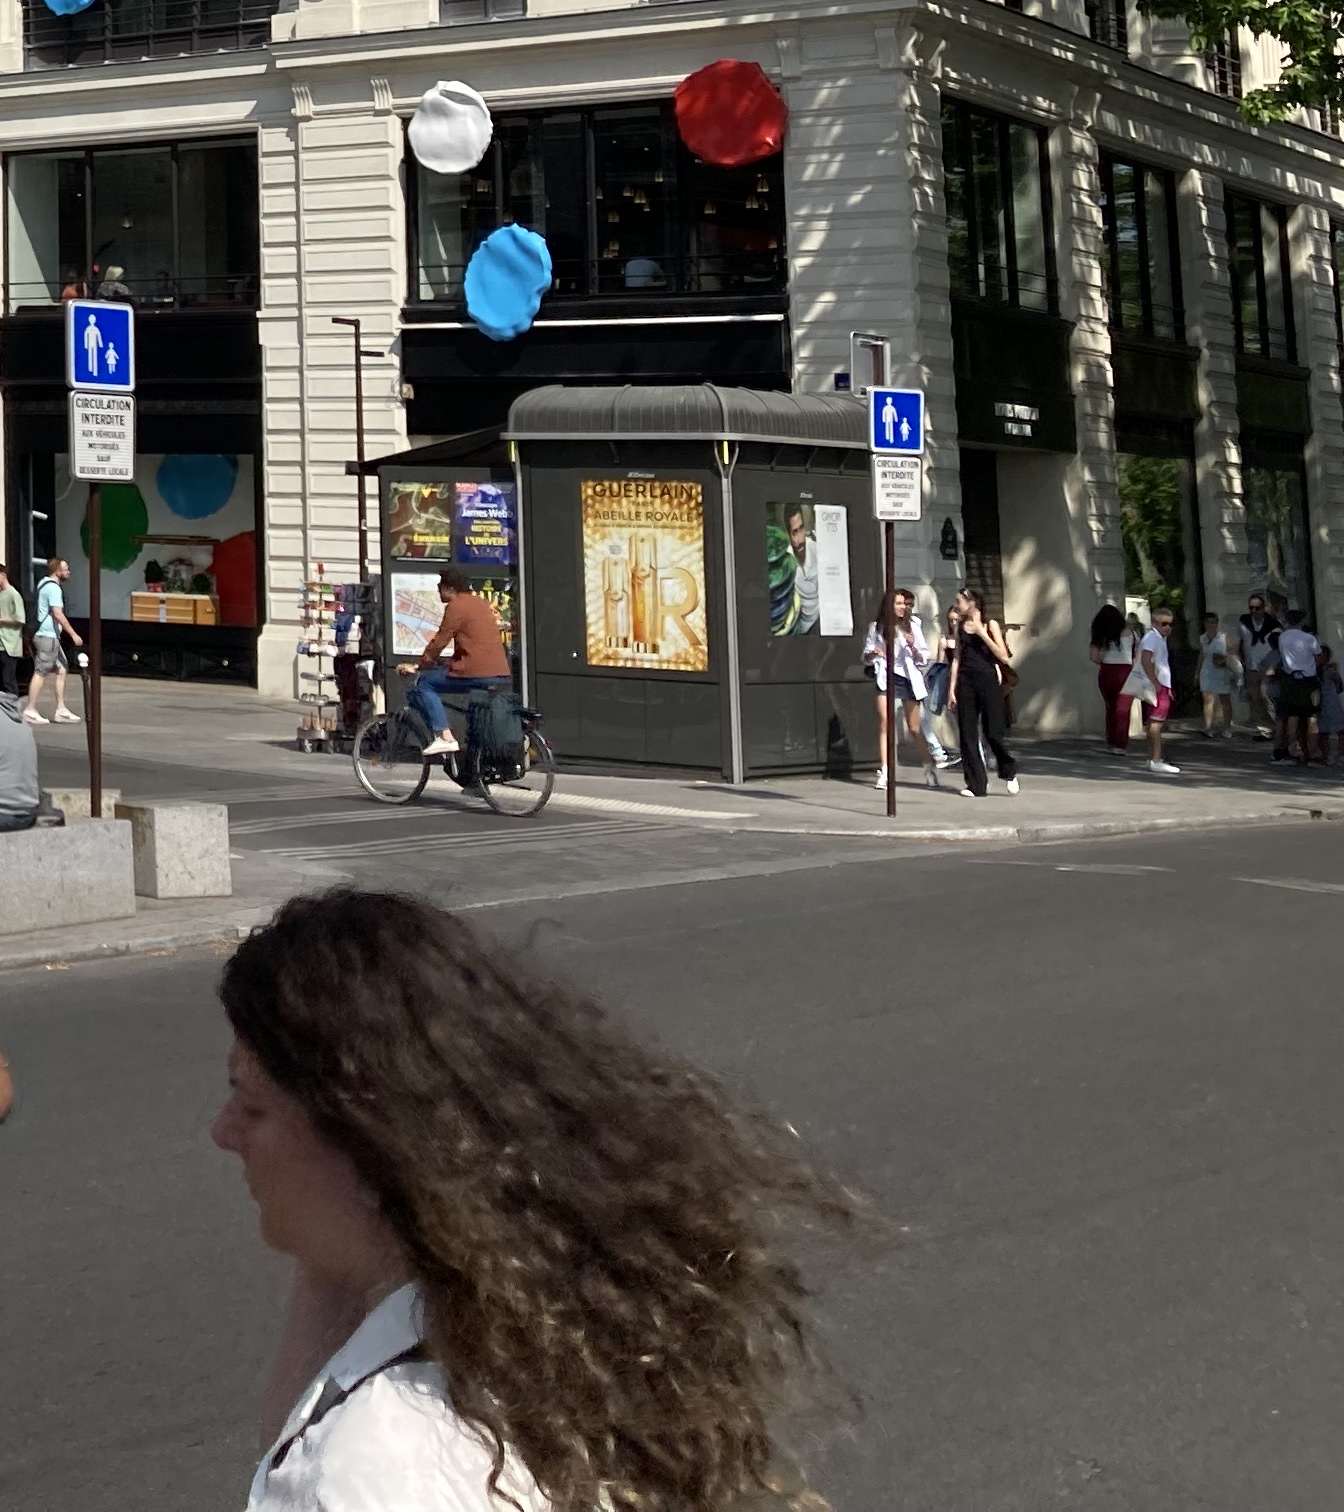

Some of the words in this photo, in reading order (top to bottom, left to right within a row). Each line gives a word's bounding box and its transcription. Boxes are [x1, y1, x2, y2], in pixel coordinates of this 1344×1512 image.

[75, 398, 131, 411] CIRCULATION
[81, 413, 125, 426] INTERDITE
[877, 459, 919, 470] CIRCULATION
[881, 471, 914, 480] INTERDITE
[592, 482, 693, 499] GUERLAIN
[594, 510, 642, 521] ABEILLE
[645, 511, 693, 522] ROYALE
